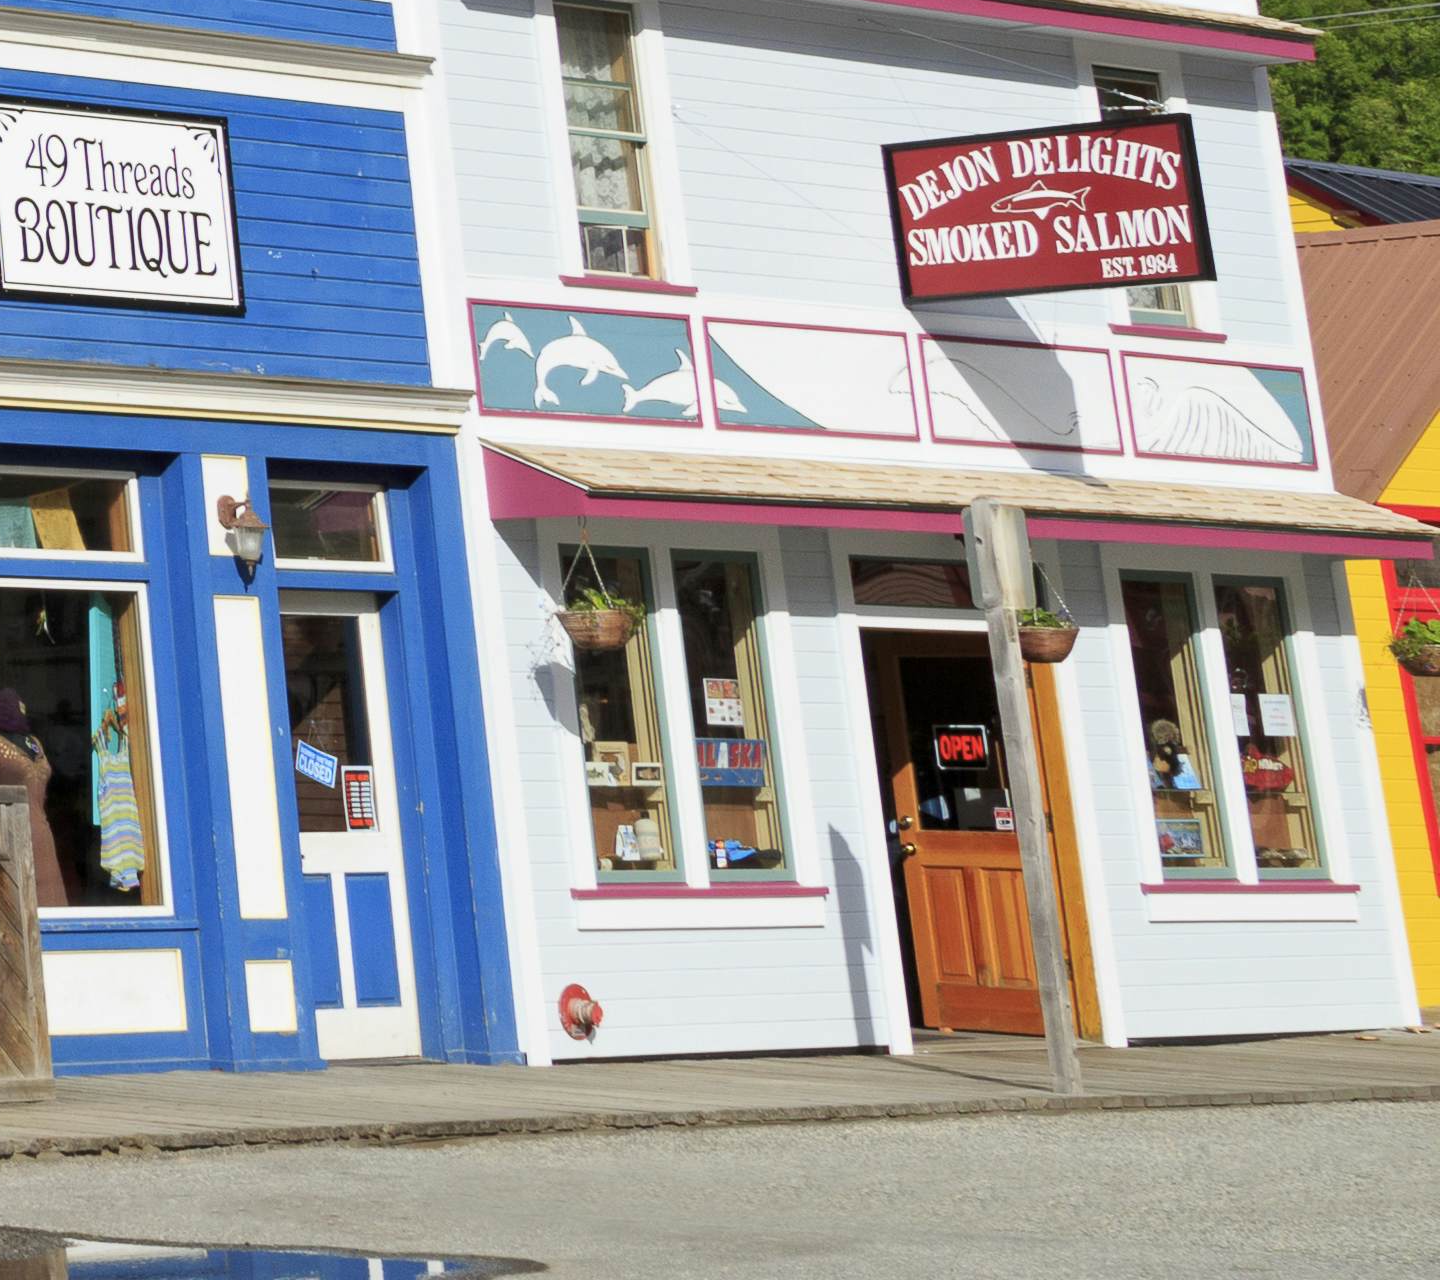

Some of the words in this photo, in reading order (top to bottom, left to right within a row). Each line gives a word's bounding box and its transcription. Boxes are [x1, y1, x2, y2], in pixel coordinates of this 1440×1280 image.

[25, 132, 68, 188] 49
[73, 137, 196, 200] Threads
[898, 146, 1001, 222] DEJON
[1007, 134, 1182, 191] DELIGHTS
[13, 196, 218, 278] BOUTIQUE
[908, 219, 1040, 267] SMOKED
[1053, 205, 1192, 255] SALMON
[1100, 257, 1134, 280] EST.
[1139, 252, 1179, 276] 1984
[299, 754, 333, 783] CLOSED
[696, 741, 762, 769] ALASKA
[938, 734, 984, 762] OPEN
